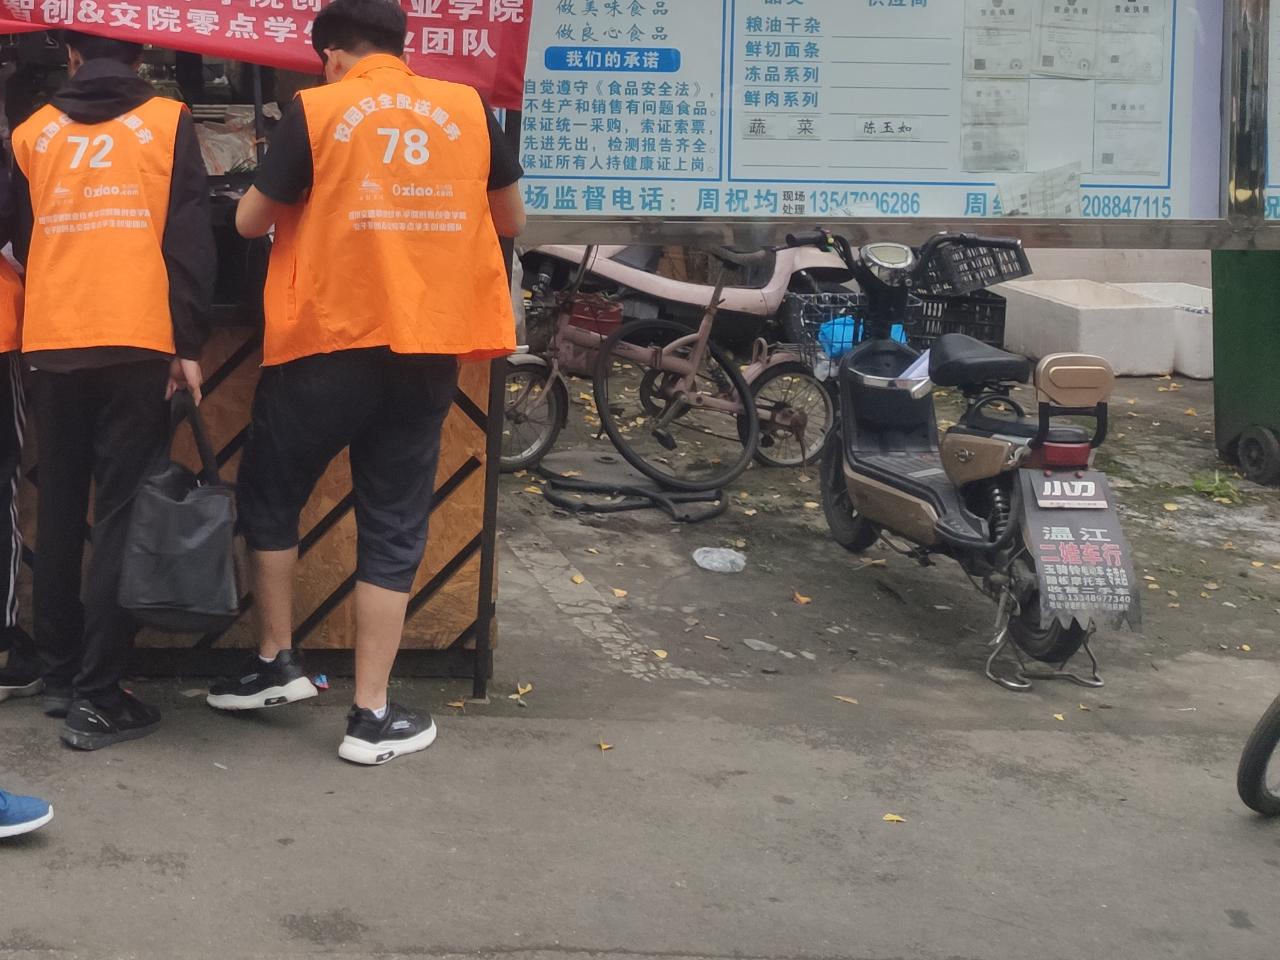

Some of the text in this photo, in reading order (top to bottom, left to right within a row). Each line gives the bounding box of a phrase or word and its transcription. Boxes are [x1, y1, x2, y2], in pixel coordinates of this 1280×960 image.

[555, 23, 669, 43] 做良心食品
[745, 16, 821, 34] 粮油干杂
[744, 41, 820, 58] 鲜切面条
[566, 50, 660, 69] 我们的承诺
[744, 65, 819, 83] 冻品系列
[743, 90, 818, 108] 鲜肉系列
[748, 118, 815, 136] 蔬菜
[67, 134, 114, 169] 72
[376, 127, 430, 165] 78
[696, 189, 779, 213] 周祝均
[1081, 195, 1172, 219] 208847115
[782, 190, 806, 203] 现场
[782, 203, 806, 216] 处理
[1042, 526, 1112, 542] 温江
